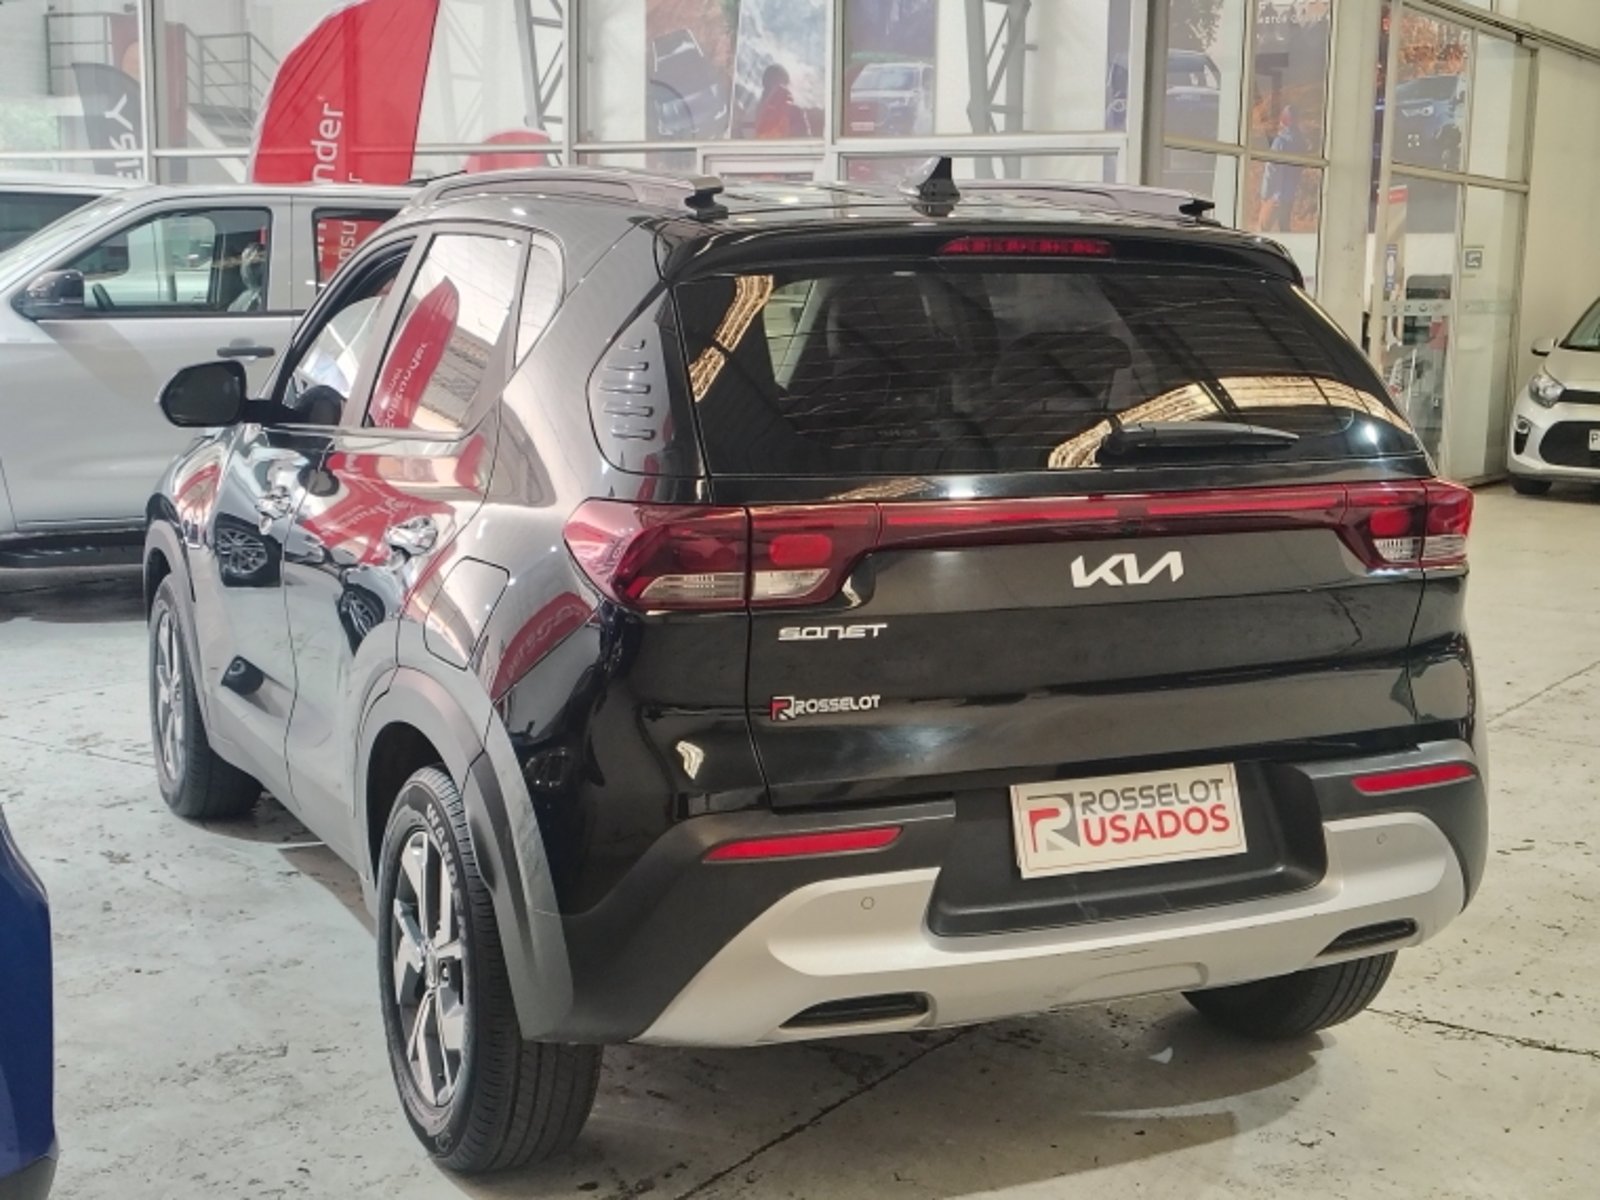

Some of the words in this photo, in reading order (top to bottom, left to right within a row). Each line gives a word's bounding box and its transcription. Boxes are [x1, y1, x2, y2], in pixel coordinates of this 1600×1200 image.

[1071, 551, 1184, 588] KIA
[795, 694, 881, 715] ROSSELOT
[1080, 779, 1224, 815] ROSSELOT
[1083, 804, 1230, 847] USADOS
